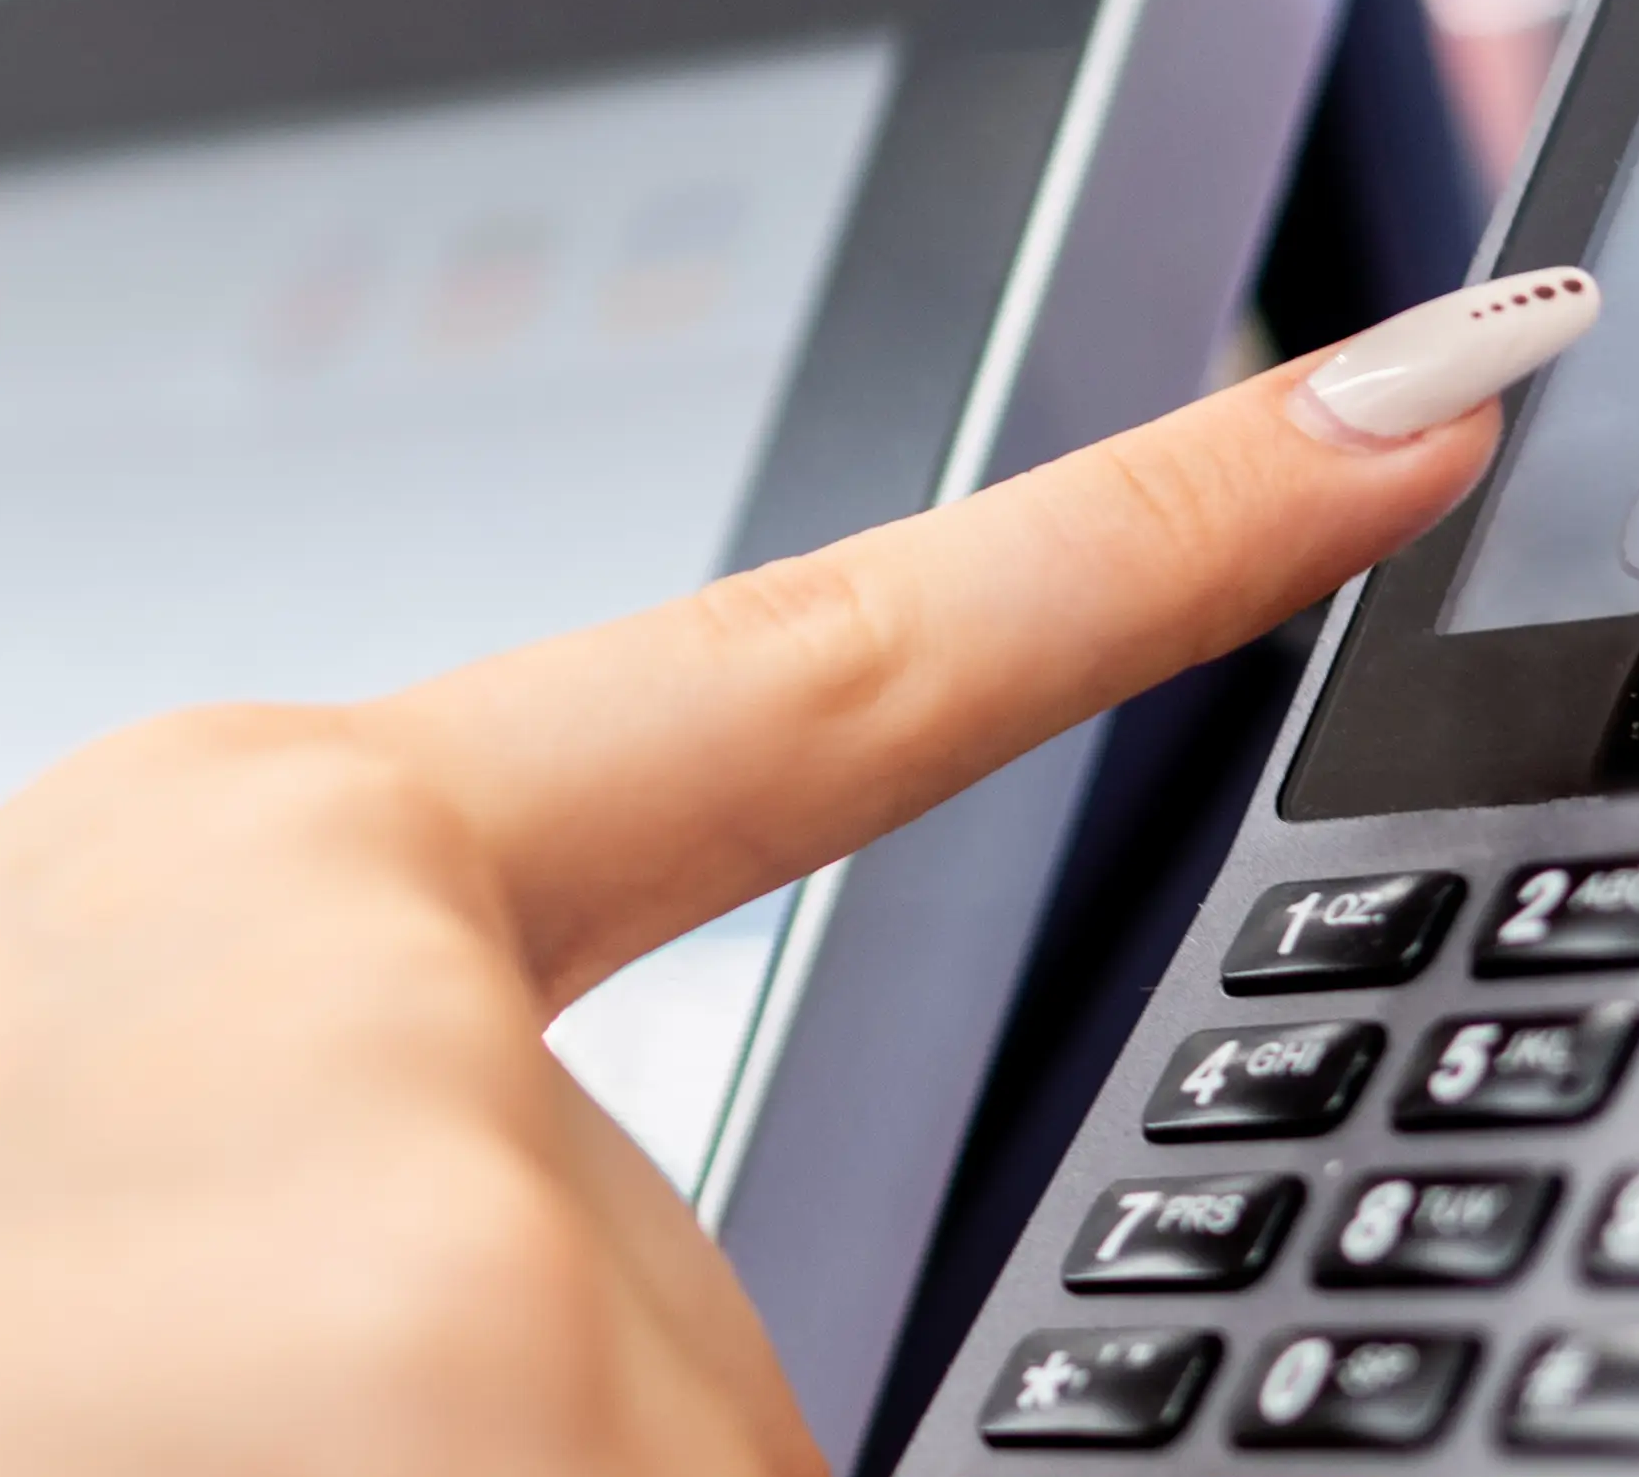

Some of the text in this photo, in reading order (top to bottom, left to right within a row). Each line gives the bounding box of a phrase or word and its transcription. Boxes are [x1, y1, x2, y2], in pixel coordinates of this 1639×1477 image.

[1277, 891, 1322, 956] 1
[1497, 869, 1571, 946] 2
[1180, 1039, 1327, 1106] 4 GHI
[1427, 1022, 1503, 1105] 5
[1095, 1190, 1246, 1262] 7 PRS
[1339, 1178, 1416, 1266] 8
[1257, 1336, 1334, 1426] 0
